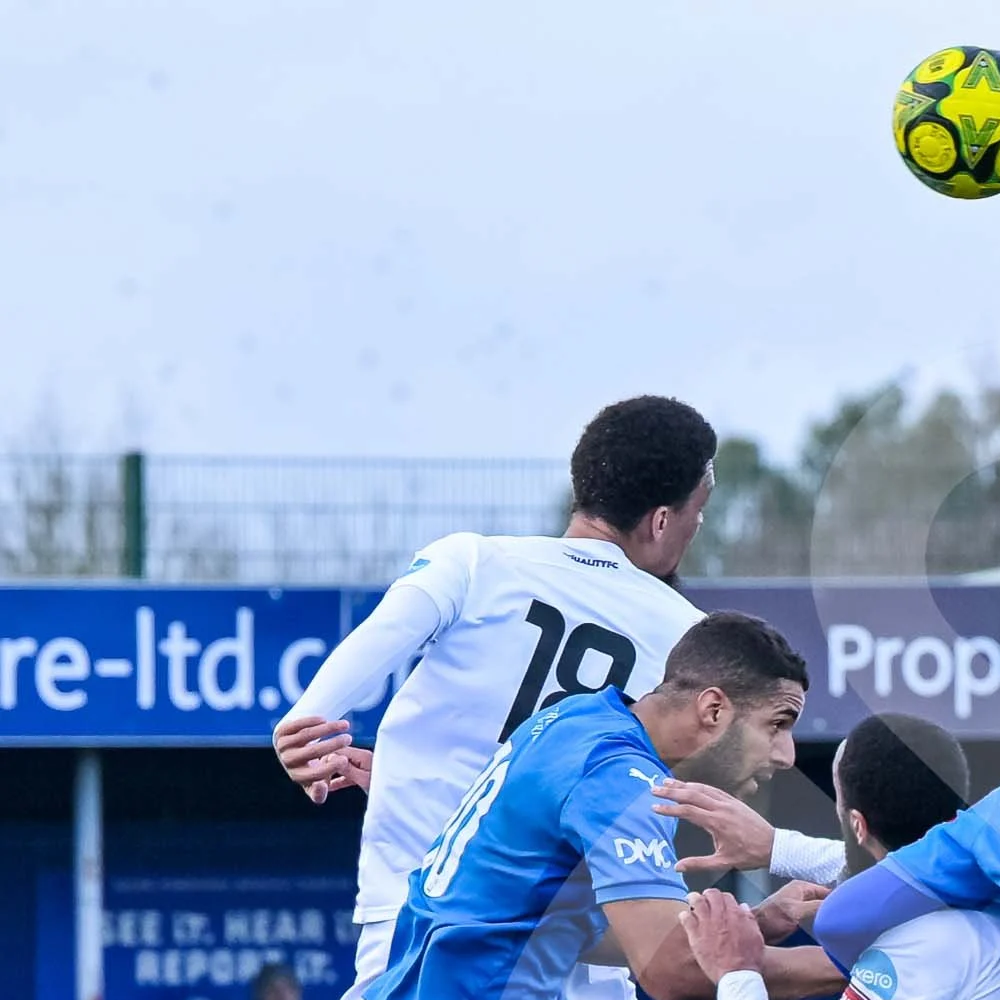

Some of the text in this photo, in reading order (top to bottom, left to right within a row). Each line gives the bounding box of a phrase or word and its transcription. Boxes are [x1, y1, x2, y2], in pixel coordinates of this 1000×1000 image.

[0, 605, 415, 711] re-ltd.c
[497, 598, 637, 744] 18
[614, 837, 672, 869] DMC
[223, 908, 326, 946] HEAR
